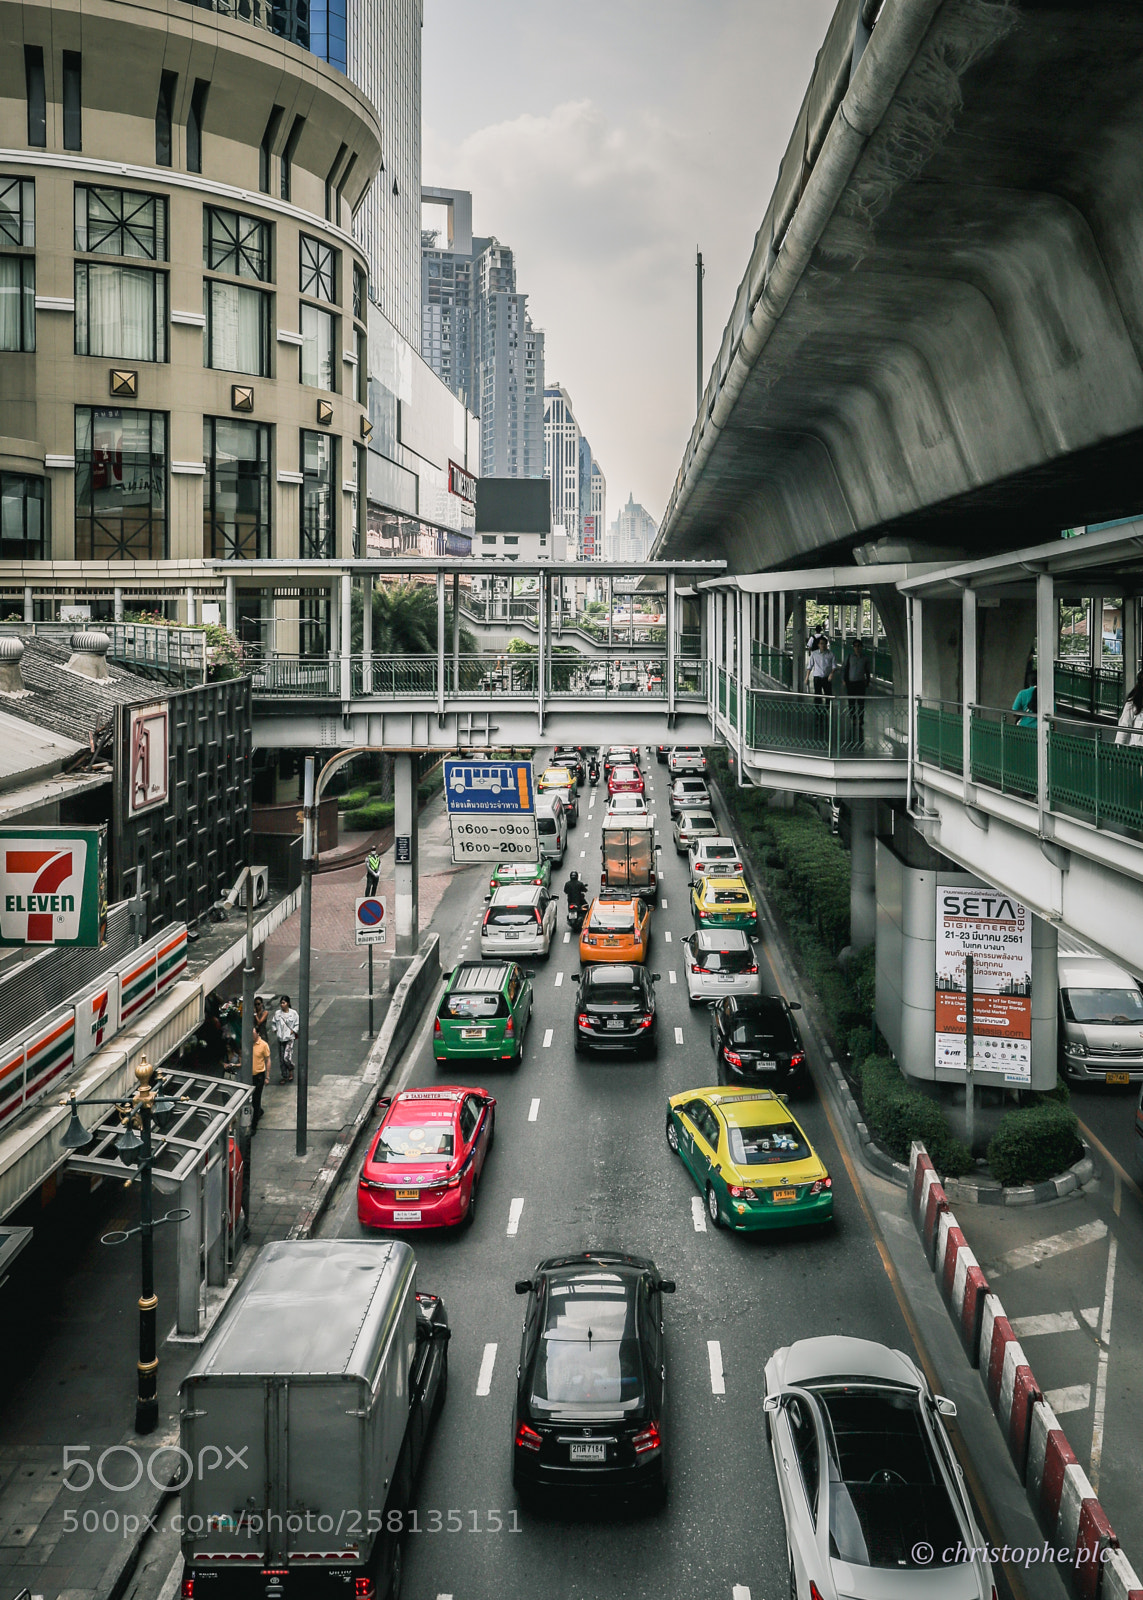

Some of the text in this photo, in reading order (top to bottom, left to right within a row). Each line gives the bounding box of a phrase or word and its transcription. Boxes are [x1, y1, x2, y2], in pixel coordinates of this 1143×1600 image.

[450, 799, 519, 809] ช่องเดินรถประจำทาง
[943, 896, 1017, 919] SETA
[945, 930, 1023, 944] 21-23 มีนาคม 2561
[587, 1445, 604, 1453] 7184
